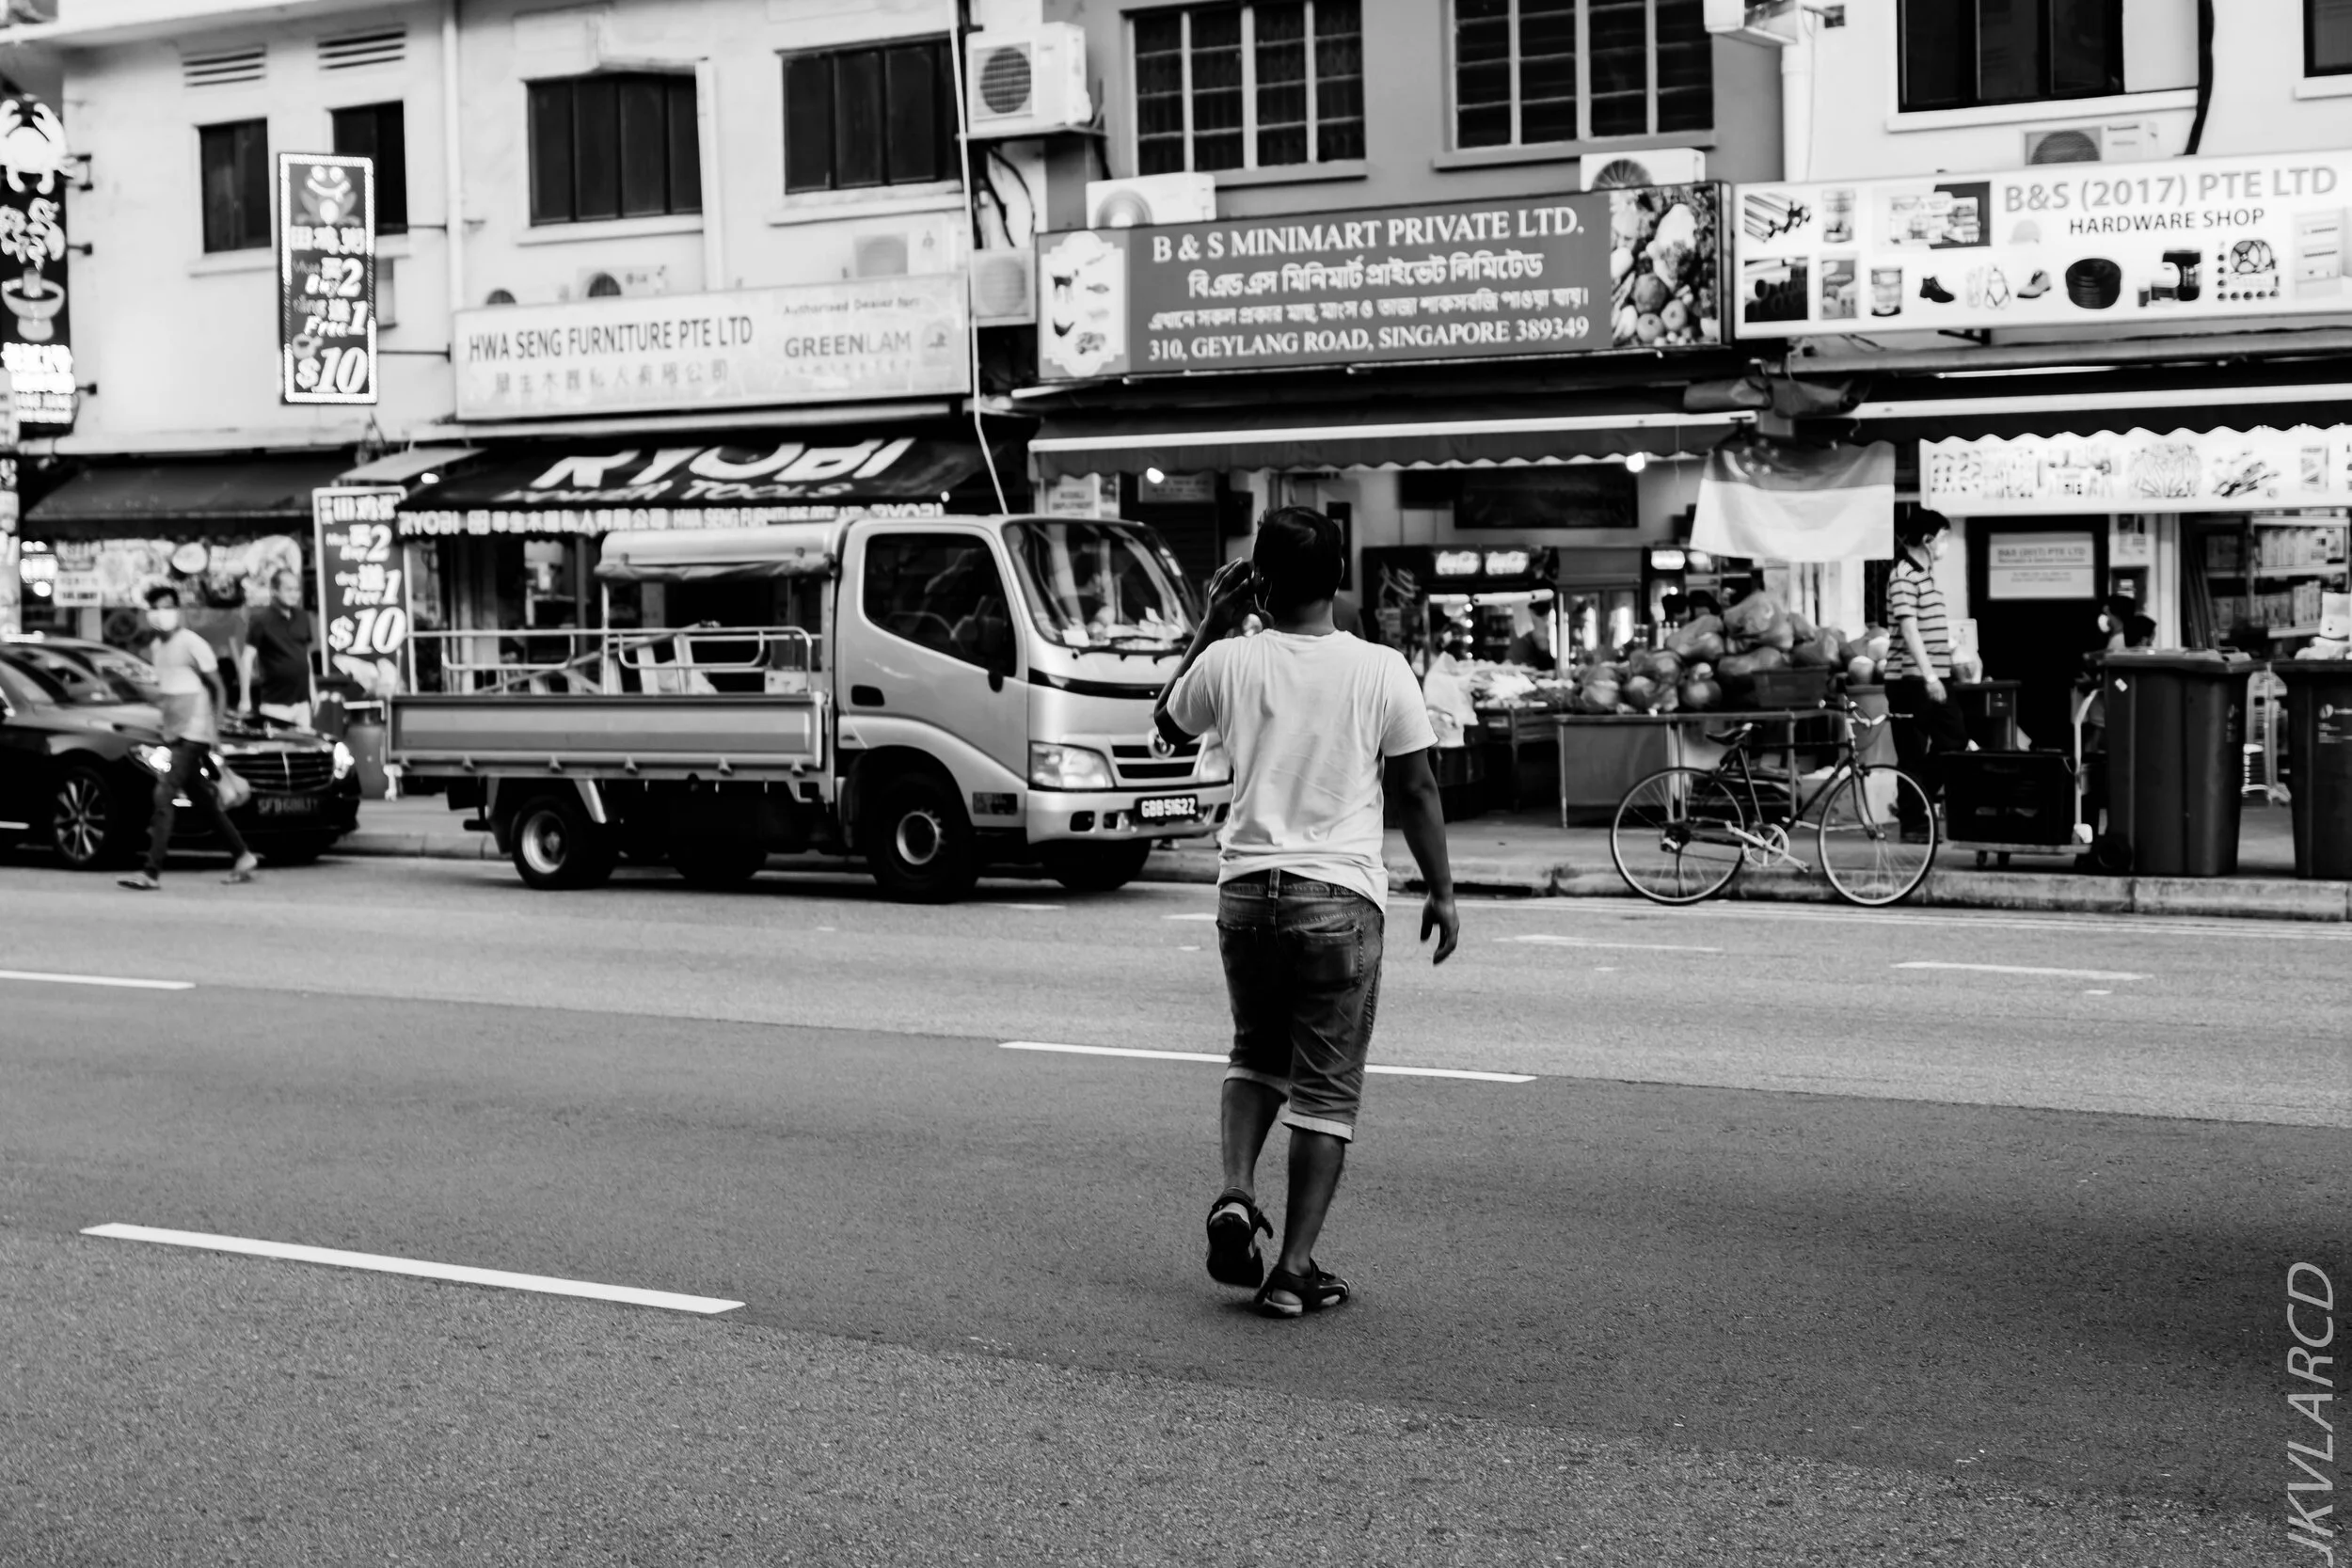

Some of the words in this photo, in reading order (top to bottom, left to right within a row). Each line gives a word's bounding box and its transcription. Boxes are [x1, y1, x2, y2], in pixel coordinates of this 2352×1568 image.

[2005, 182, 2070, 213] B&S
[2081, 173, 2187, 212] (2017)
[2198, 169, 2262, 200] PTE
[2272, 166, 2337, 197] LTD
[1152, 236, 1172, 262] B
[1178, 233, 1201, 261] &
[1207, 231, 1224, 259] S
[1230, 220, 1382, 258] MINIMART
[1387, 211, 1511, 246] PRIVATE
[1518, 206, 1585, 237] LTD.
[2070, 211, 2196, 235] HARDWARE
[2202, 207, 2265, 229] SHOP
[337, 257, 364, 297] 2
[348, 300, 368, 336] 1
[469, 333, 510, 362] HWA
[516, 329, 562, 358] SENG
[568, 321, 673, 355] FURNITURE
[679, 318, 711, 348] PTE
[719, 316, 753, 345] LTD
[1148, 339, 1188, 362] 310,
[1191, 331, 1298, 358] GEYLANG
[1304, 328, 1374, 353] ROAD,
[1378, 320, 1511, 349] SINGAPORE
[1516, 316, 1590, 341] 389349
[785, 330, 912, 358] GREENLAM
[295, 346, 369, 394] $10
[366, 524, 392, 562] 2
[380, 569, 402, 605] 1
[328, 606, 407, 655] $10
